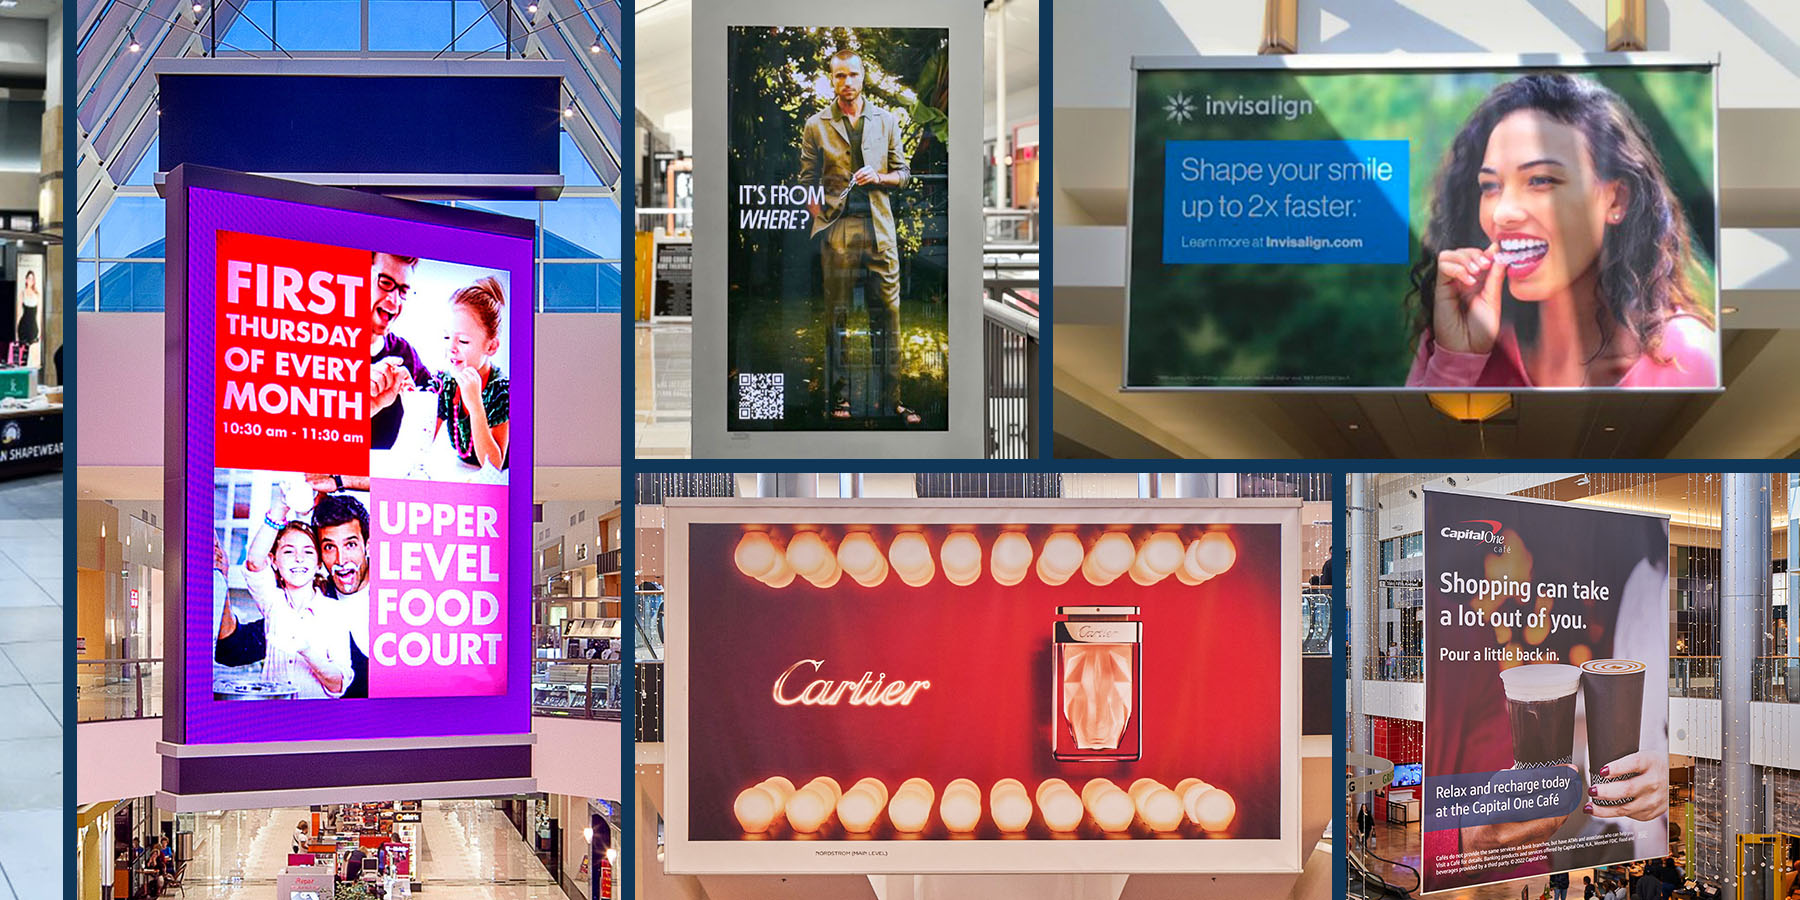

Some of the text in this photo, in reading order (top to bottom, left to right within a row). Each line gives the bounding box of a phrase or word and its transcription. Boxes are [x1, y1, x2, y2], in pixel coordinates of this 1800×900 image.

[1206, 96, 1312, 120] invisalign
[1181, 157, 1392, 185] Shape your smile
[740, 185, 826, 206] IT'S FROM
[1182, 200, 1213, 222] up
[1220, 195, 1244, 218] to
[1248, 194, 1278, 218] 2x
[740, 210, 810, 230] WHERE?
[1182, 236, 1363, 250] Learn more at Invisalign.com
[228, 260, 364, 317] FIRST
[226, 313, 362, 348] THURSDAY
[224, 346, 363, 382] OF EVERY
[223, 380, 362, 420] MONTH
[223, 422, 262, 436] 10:30
[266, 428, 288, 437] am
[302, 428, 340, 442] 11:30
[343, 434, 364, 443] am
[379, 500, 500, 538] UPPER
[380, 541, 500, 582] LEVEL
[1494, 546, 1512, 554] café
[1440, 571, 1610, 602] Shopping can take
[378, 588, 500, 626] FOOD
[1440, 604, 1586, 634] a lot out of you.
[373, 632, 502, 666] COURT
[1440, 648, 1560, 662] Pour a little back in.
[773, 659, 930, 706] Cartier
[1436, 776, 1570, 799] Relax and recharge today
[1436, 793, 1560, 818] at the Capital One Café
[1459, 864, 1478, 872] provided
